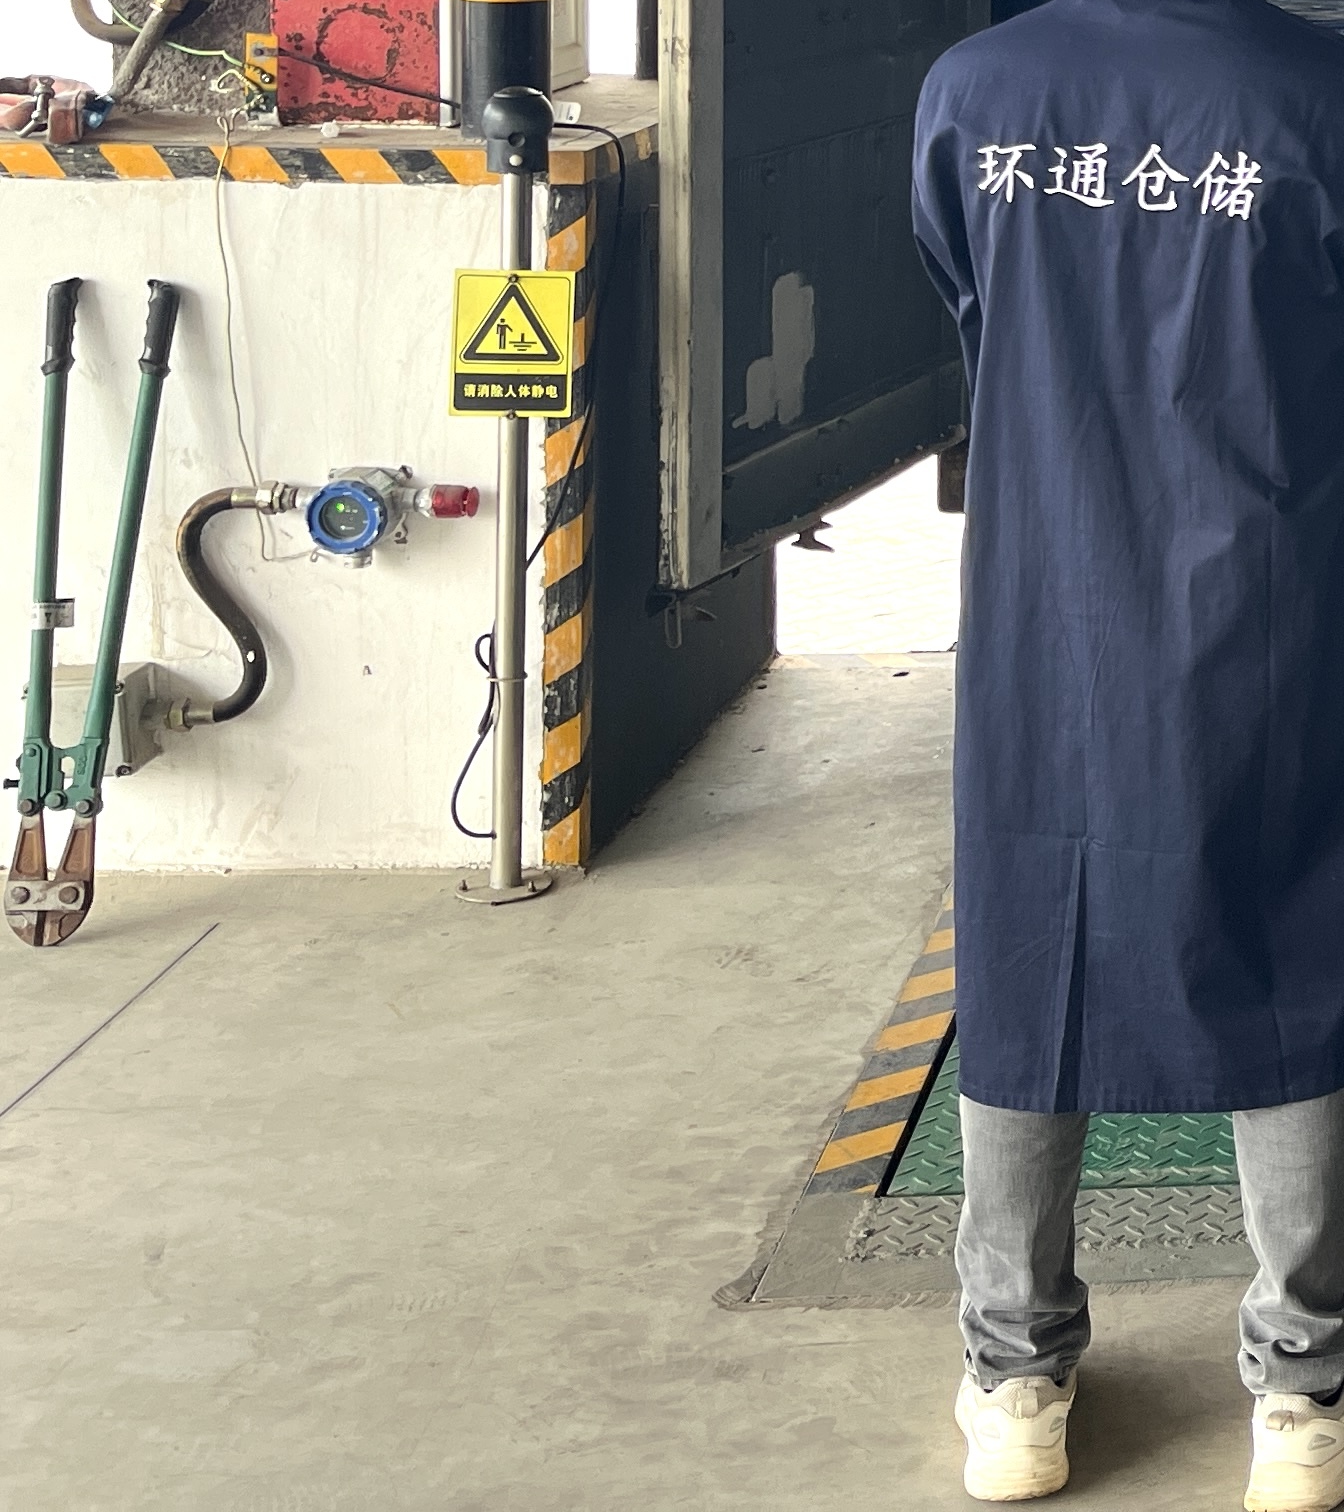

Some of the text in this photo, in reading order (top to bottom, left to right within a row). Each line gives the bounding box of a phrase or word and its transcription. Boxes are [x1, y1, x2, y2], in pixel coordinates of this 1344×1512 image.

[976, 142, 1263, 221] 环通仓储
[463, 383, 559, 399] 请消除人体静电
